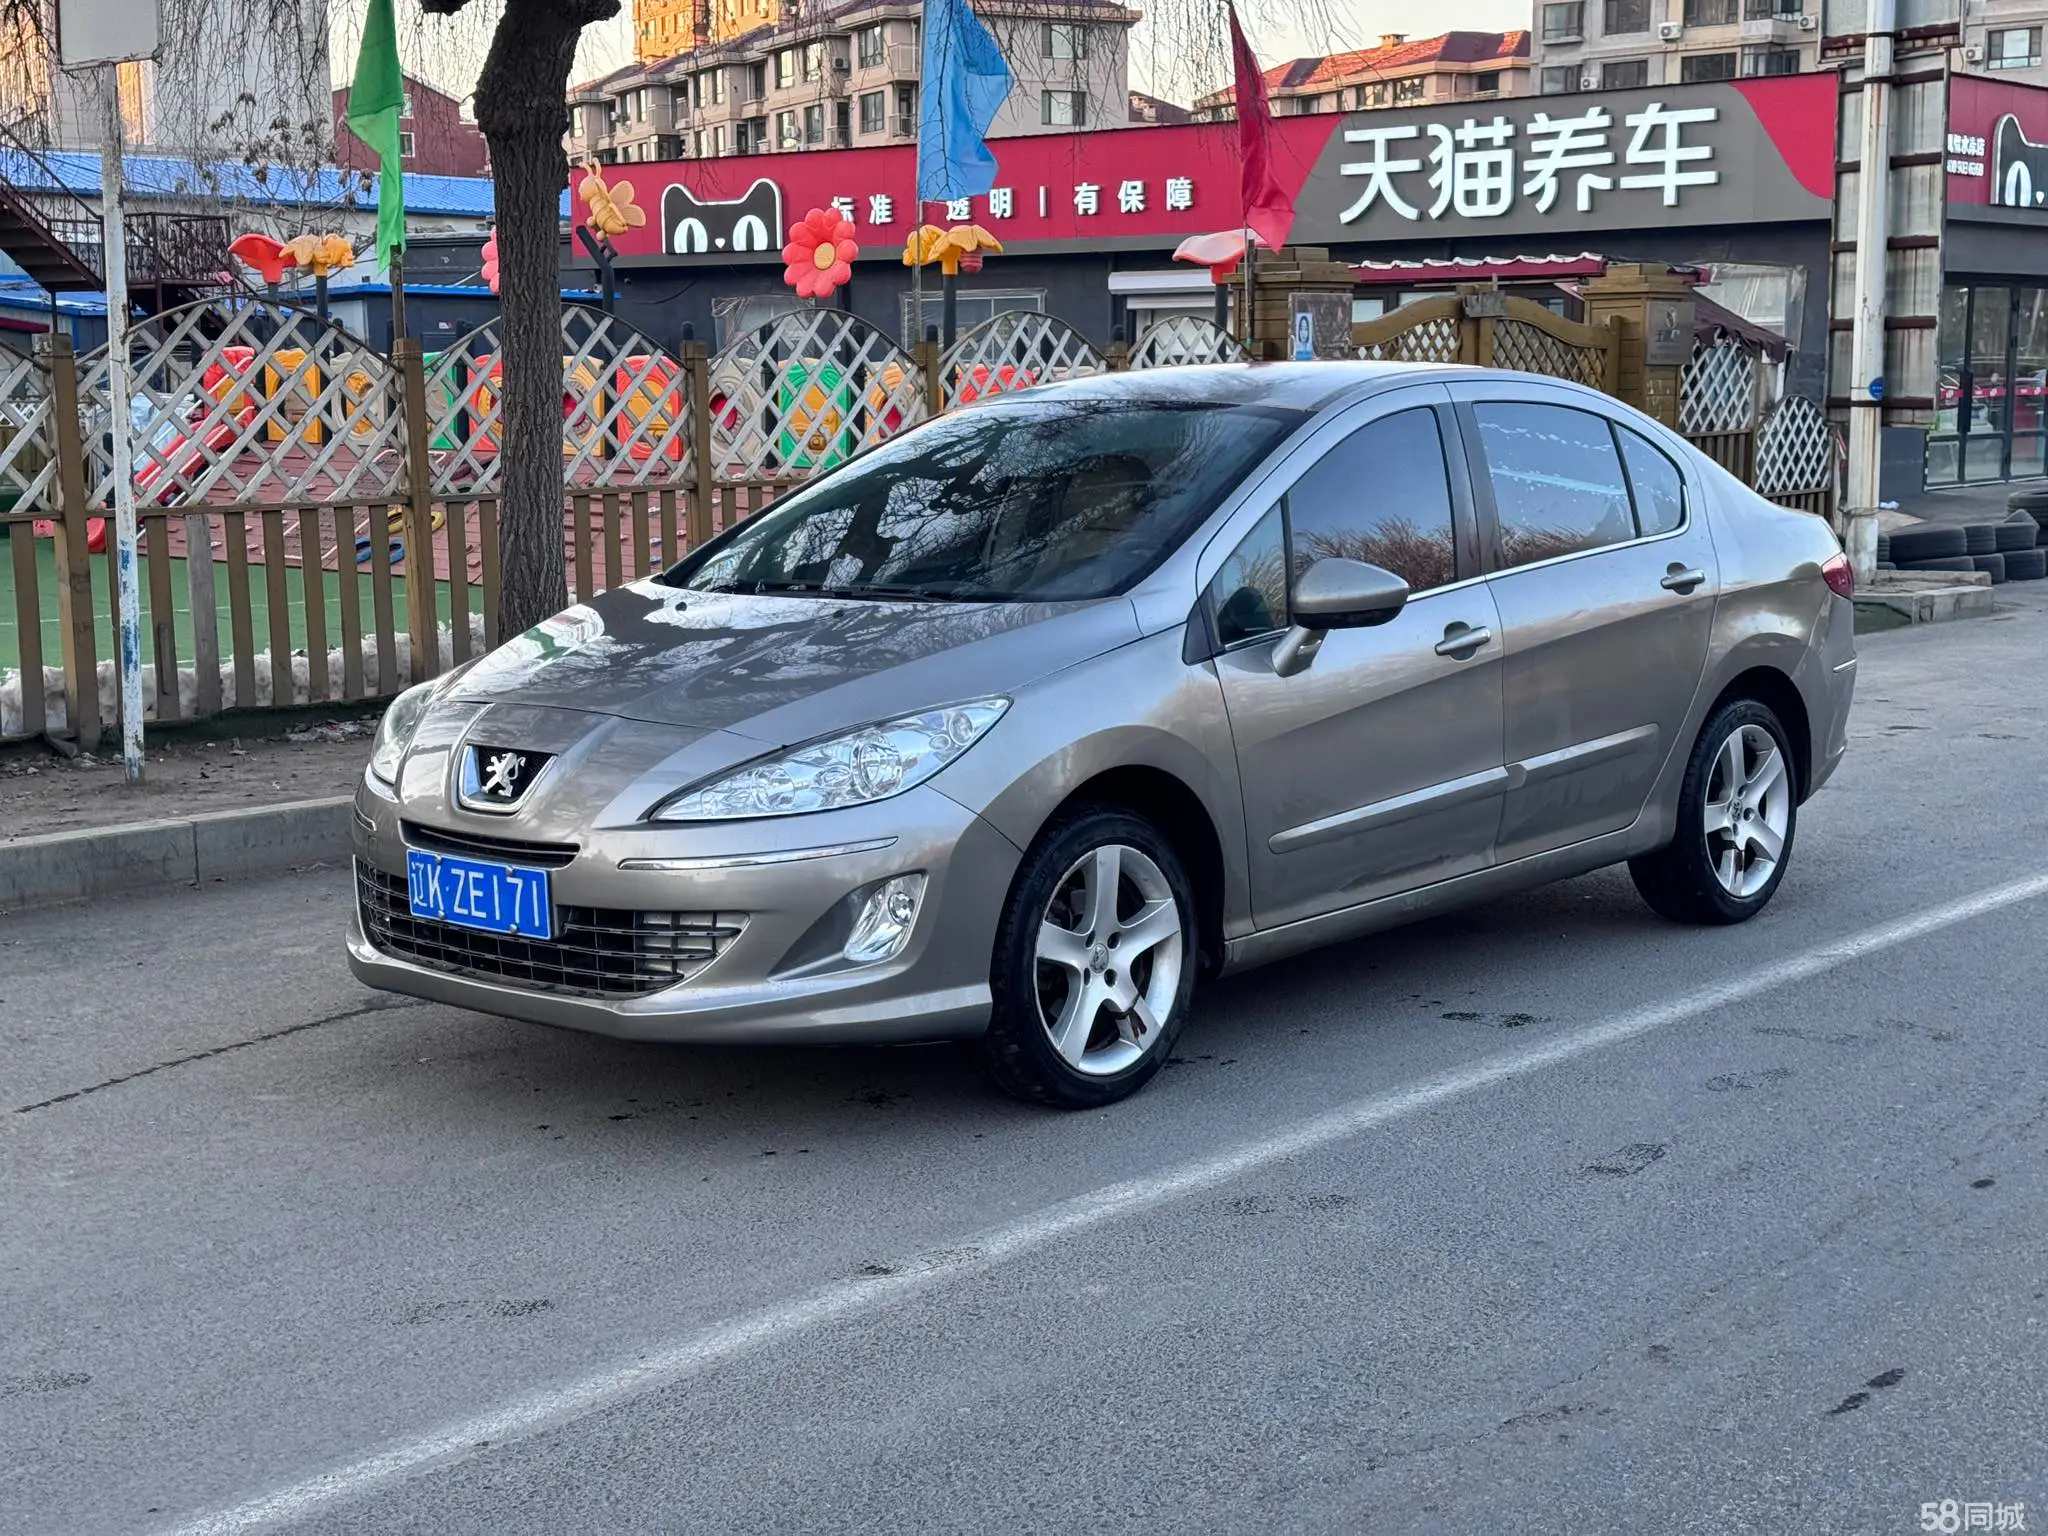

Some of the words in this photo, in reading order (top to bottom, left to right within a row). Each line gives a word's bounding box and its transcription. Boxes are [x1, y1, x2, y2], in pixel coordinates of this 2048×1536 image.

[831, 193, 893, 225] 标准
[946, 187, 1012, 221] 透明
[1074, 178, 1194, 216] 有保障
[1339, 102, 1719, 224] 天猫养车
